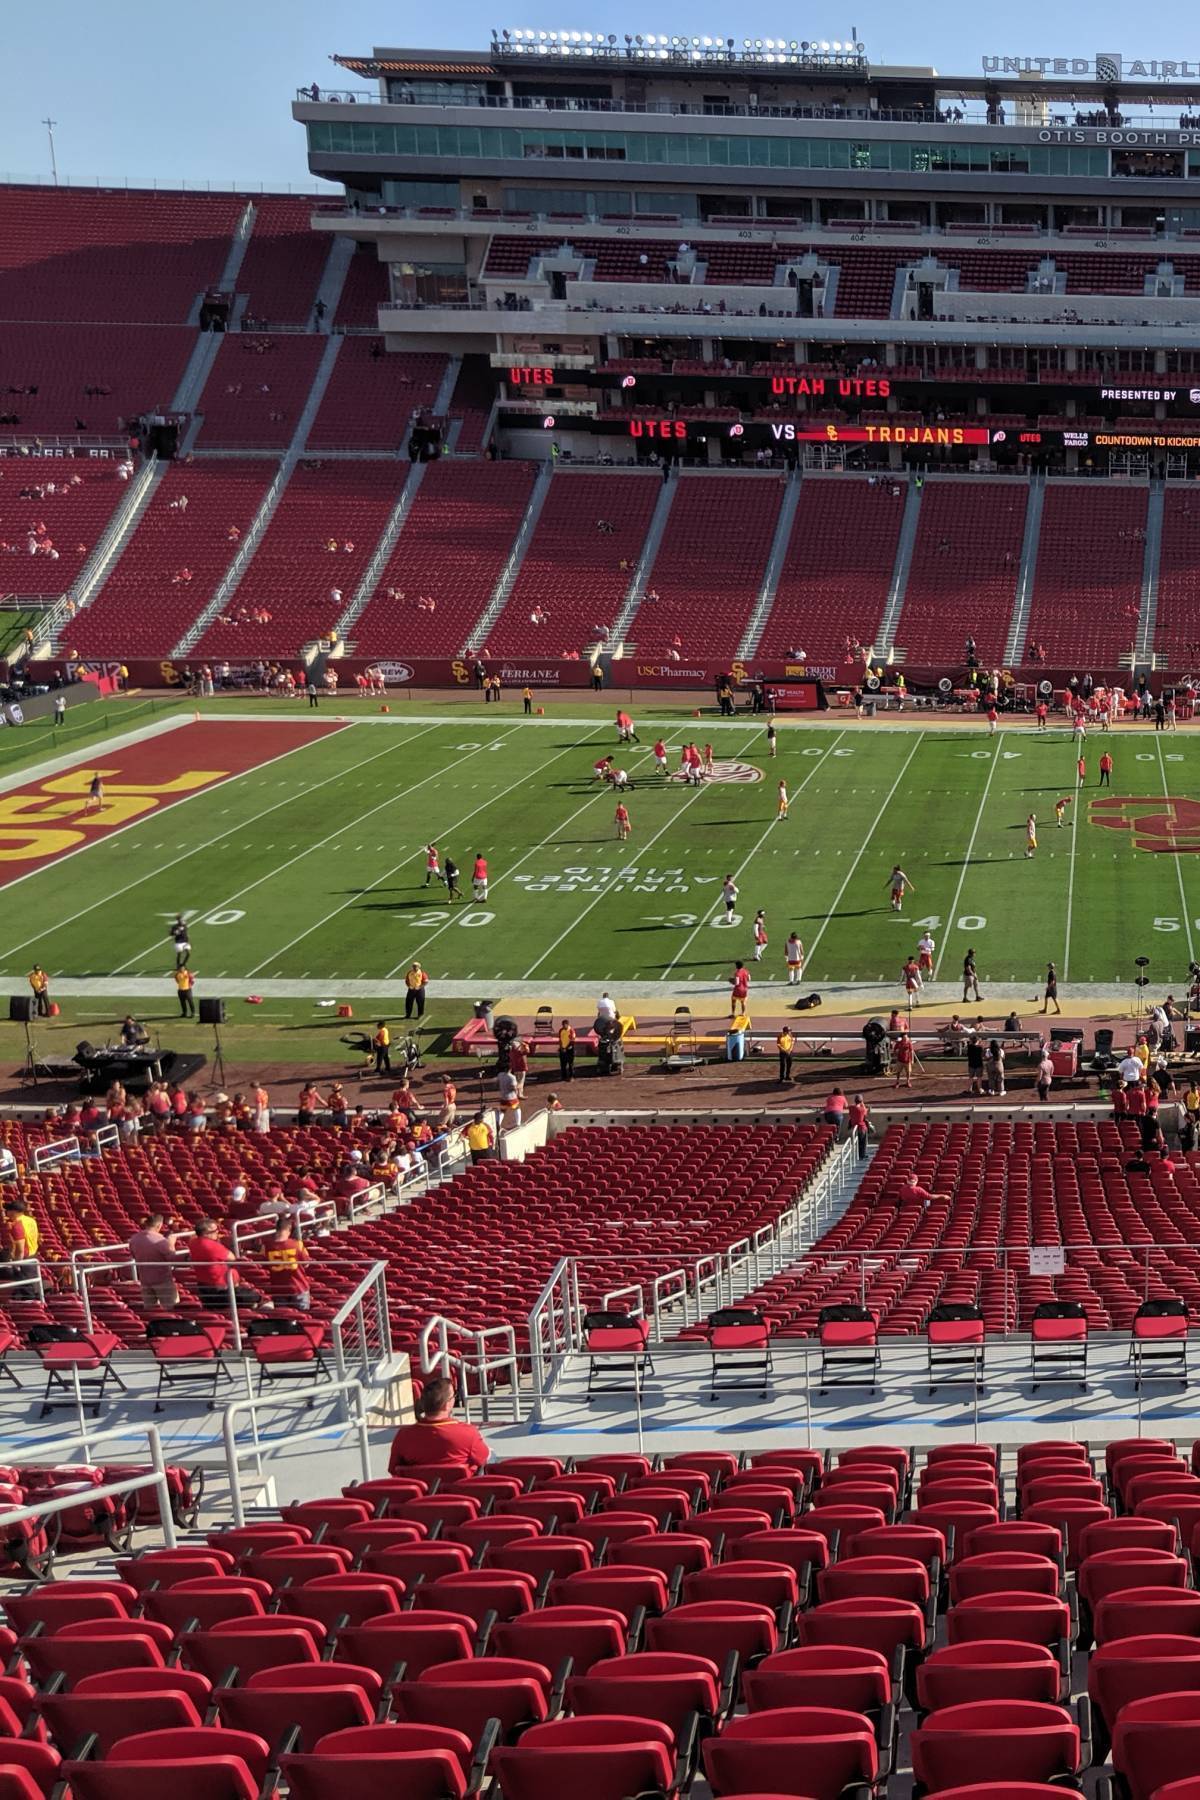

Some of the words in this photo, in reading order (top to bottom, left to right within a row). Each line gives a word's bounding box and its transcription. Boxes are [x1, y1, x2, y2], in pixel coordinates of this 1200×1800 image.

[982, 56, 1088, 75] UNITED
[1039, 130, 1086, 144] OTIS
[1096, 131, 1167, 145] BOOTH
[511, 368, 554, 384] UTES
[772, 377, 824, 394] UTAH
[840, 379, 890, 397] UTES
[1101, 389, 1160, 400] PRESENTED
[1164, 391, 1176, 400] BY
[630, 420, 687, 438] UTES
[772, 424, 795, 440] VS
[866, 426, 964, 444] TROJANS
[1020, 433, 1041, 443] UTES
[1095, 435, 1151, 446] COUNTDOWN
[1155, 437, 1165, 446] TO
[500, 669, 560, 679] TERRANEA
[636, 666, 660, 677] USC
[660, 666, 707, 682] Pharmacy
[805, 666, 837, 674] CREDIT
[512, 875, 720, 885] AIRLINES
[524, 884, 690, 893] UNITED
[409, 911, 497, 928] 20
[663, 913, 744, 929] 30
[912, 915, 987, 930] 40
